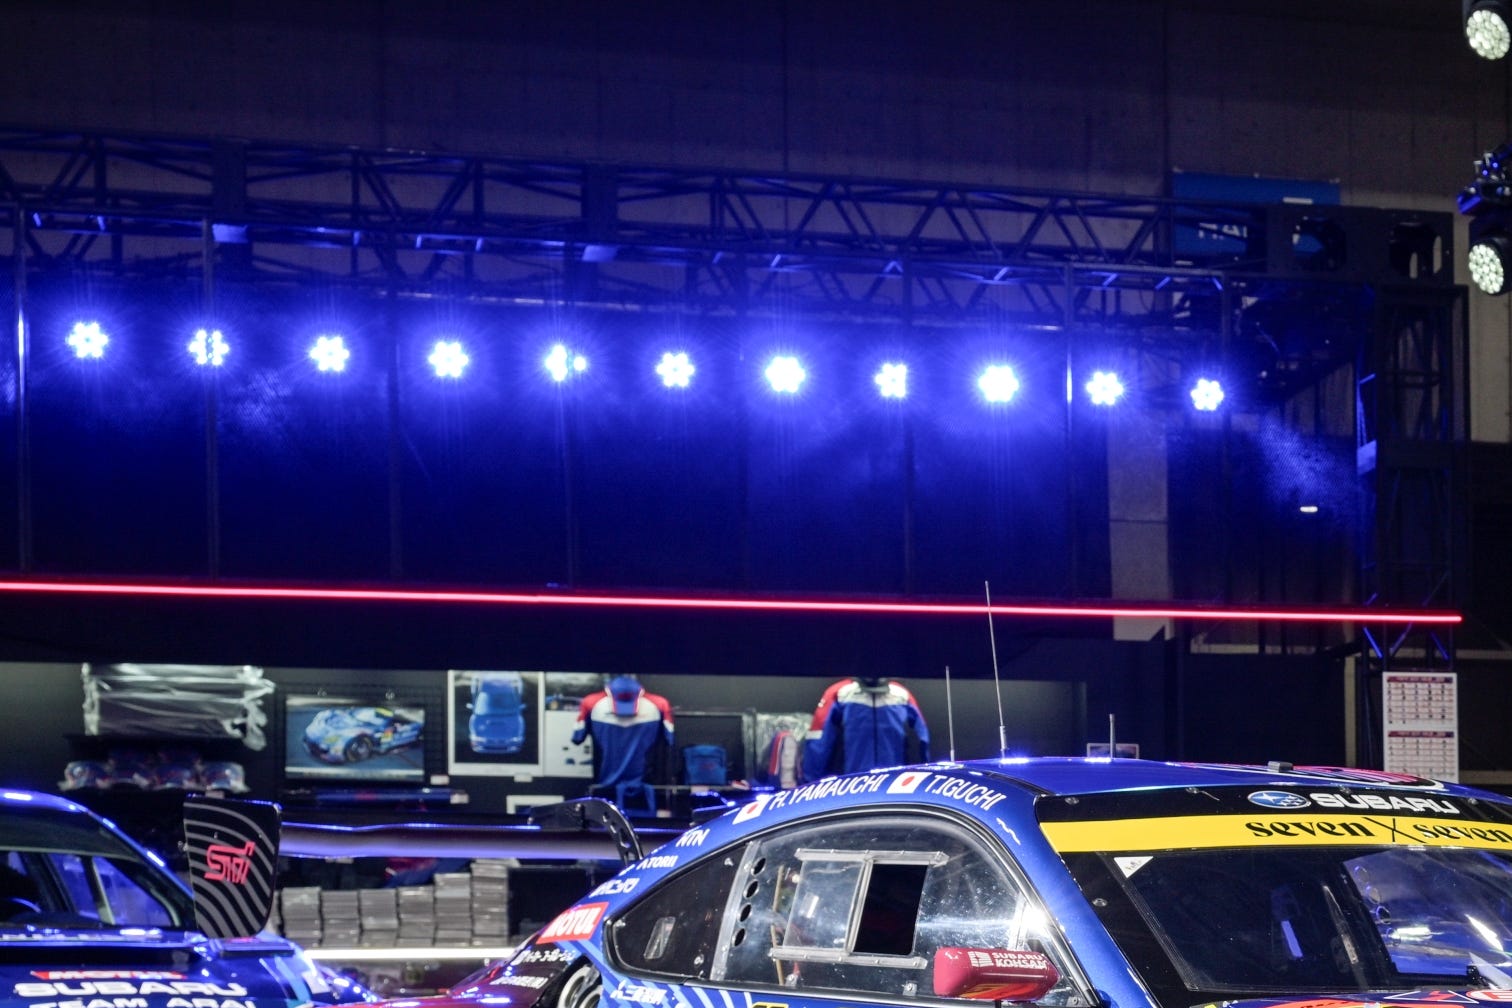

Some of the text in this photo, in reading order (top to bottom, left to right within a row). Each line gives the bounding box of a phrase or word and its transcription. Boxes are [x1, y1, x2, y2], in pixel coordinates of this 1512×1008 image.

[1309, 792, 1461, 815] SUBARU
[1246, 817, 1369, 839] seven
[541, 906, 602, 938] MOTUL
[14, 981, 248, 997] SUBARU
